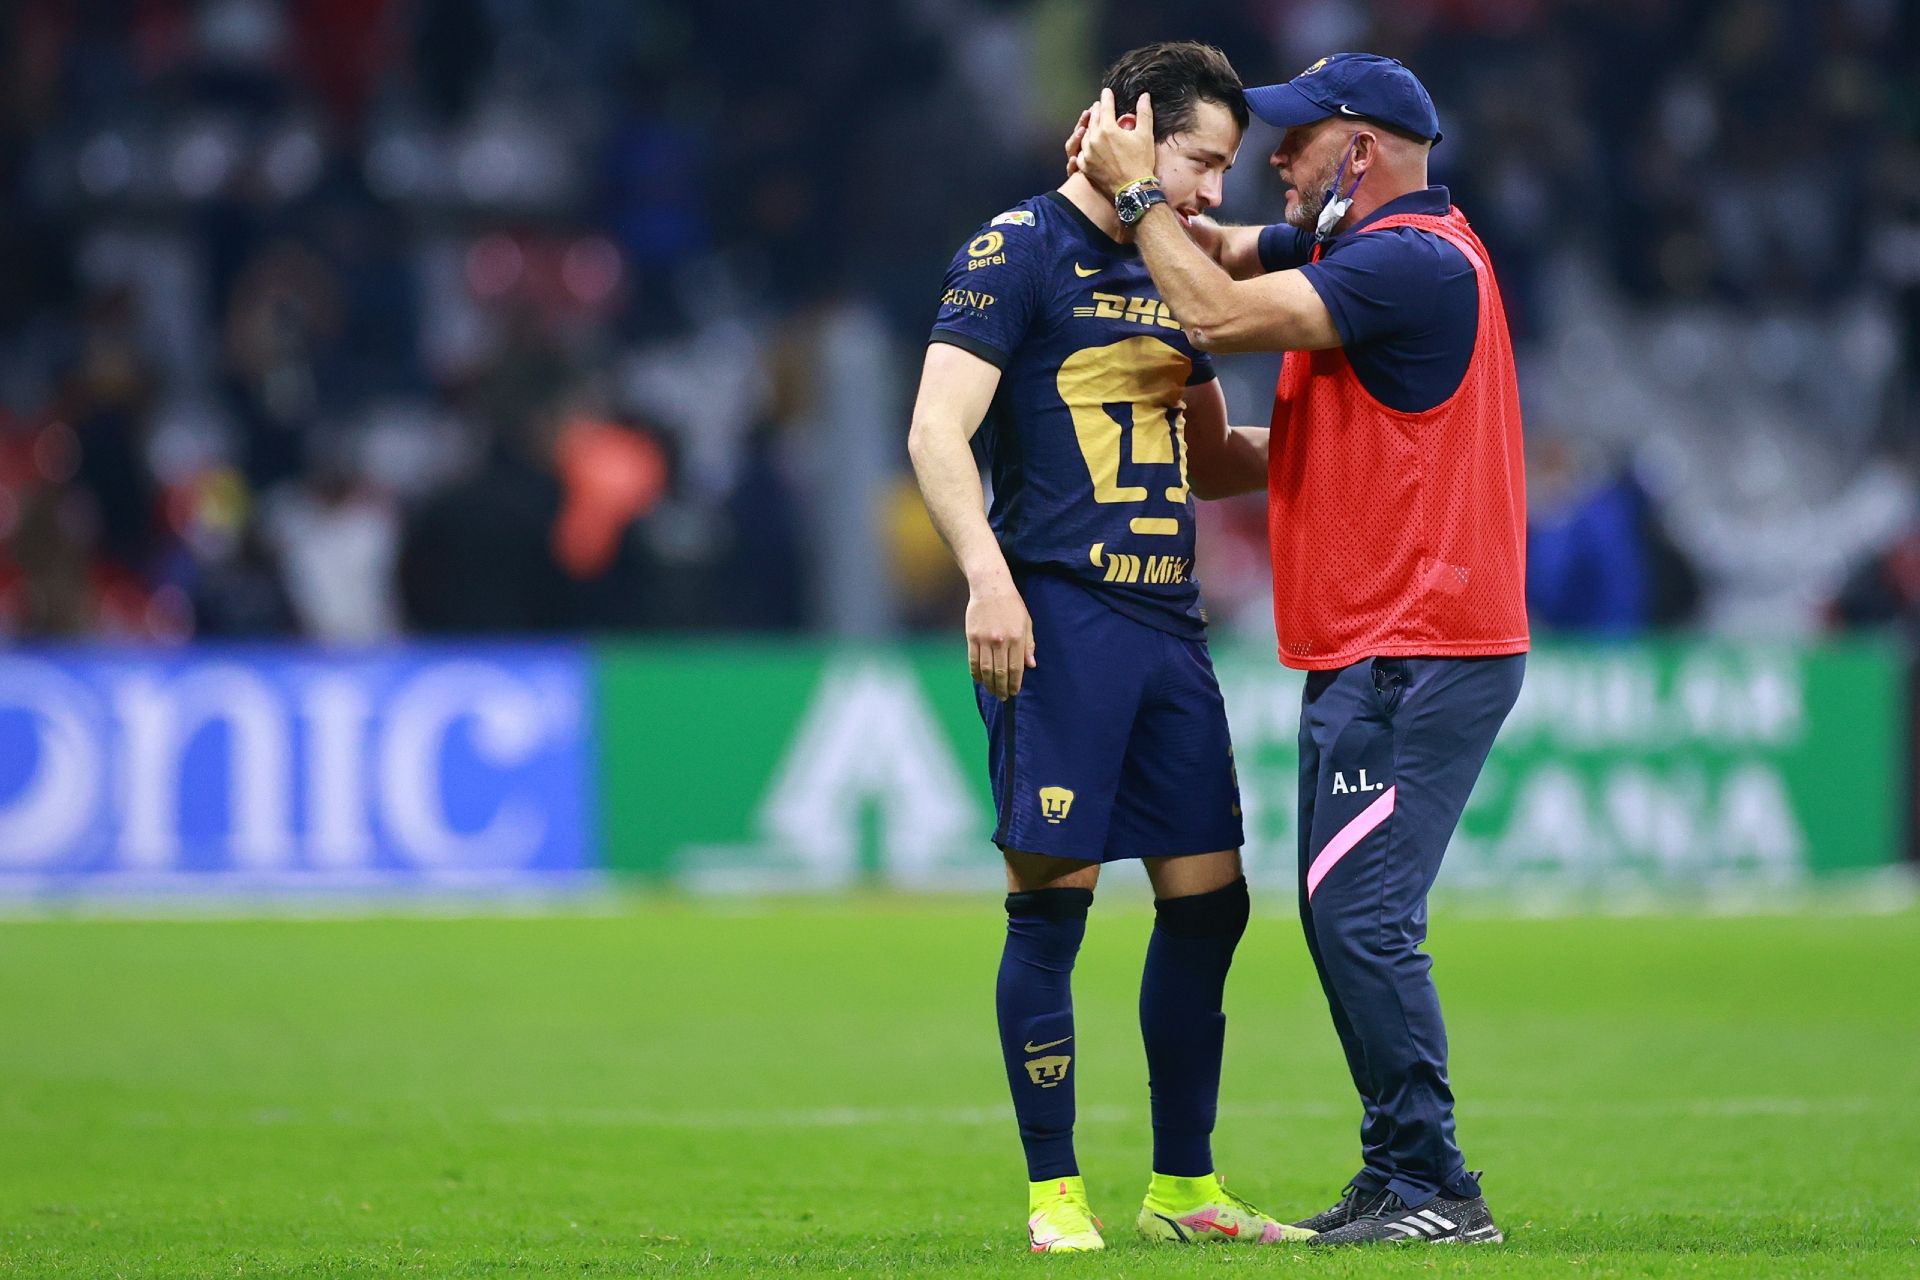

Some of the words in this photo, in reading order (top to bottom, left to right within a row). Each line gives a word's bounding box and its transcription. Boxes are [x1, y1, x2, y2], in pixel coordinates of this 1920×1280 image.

[967, 252, 1006, 271] Berel
[952, 289, 995, 311] GNP
[1092, 291, 1181, 331] DHL
[1331, 768, 1384, 795] A.L.
